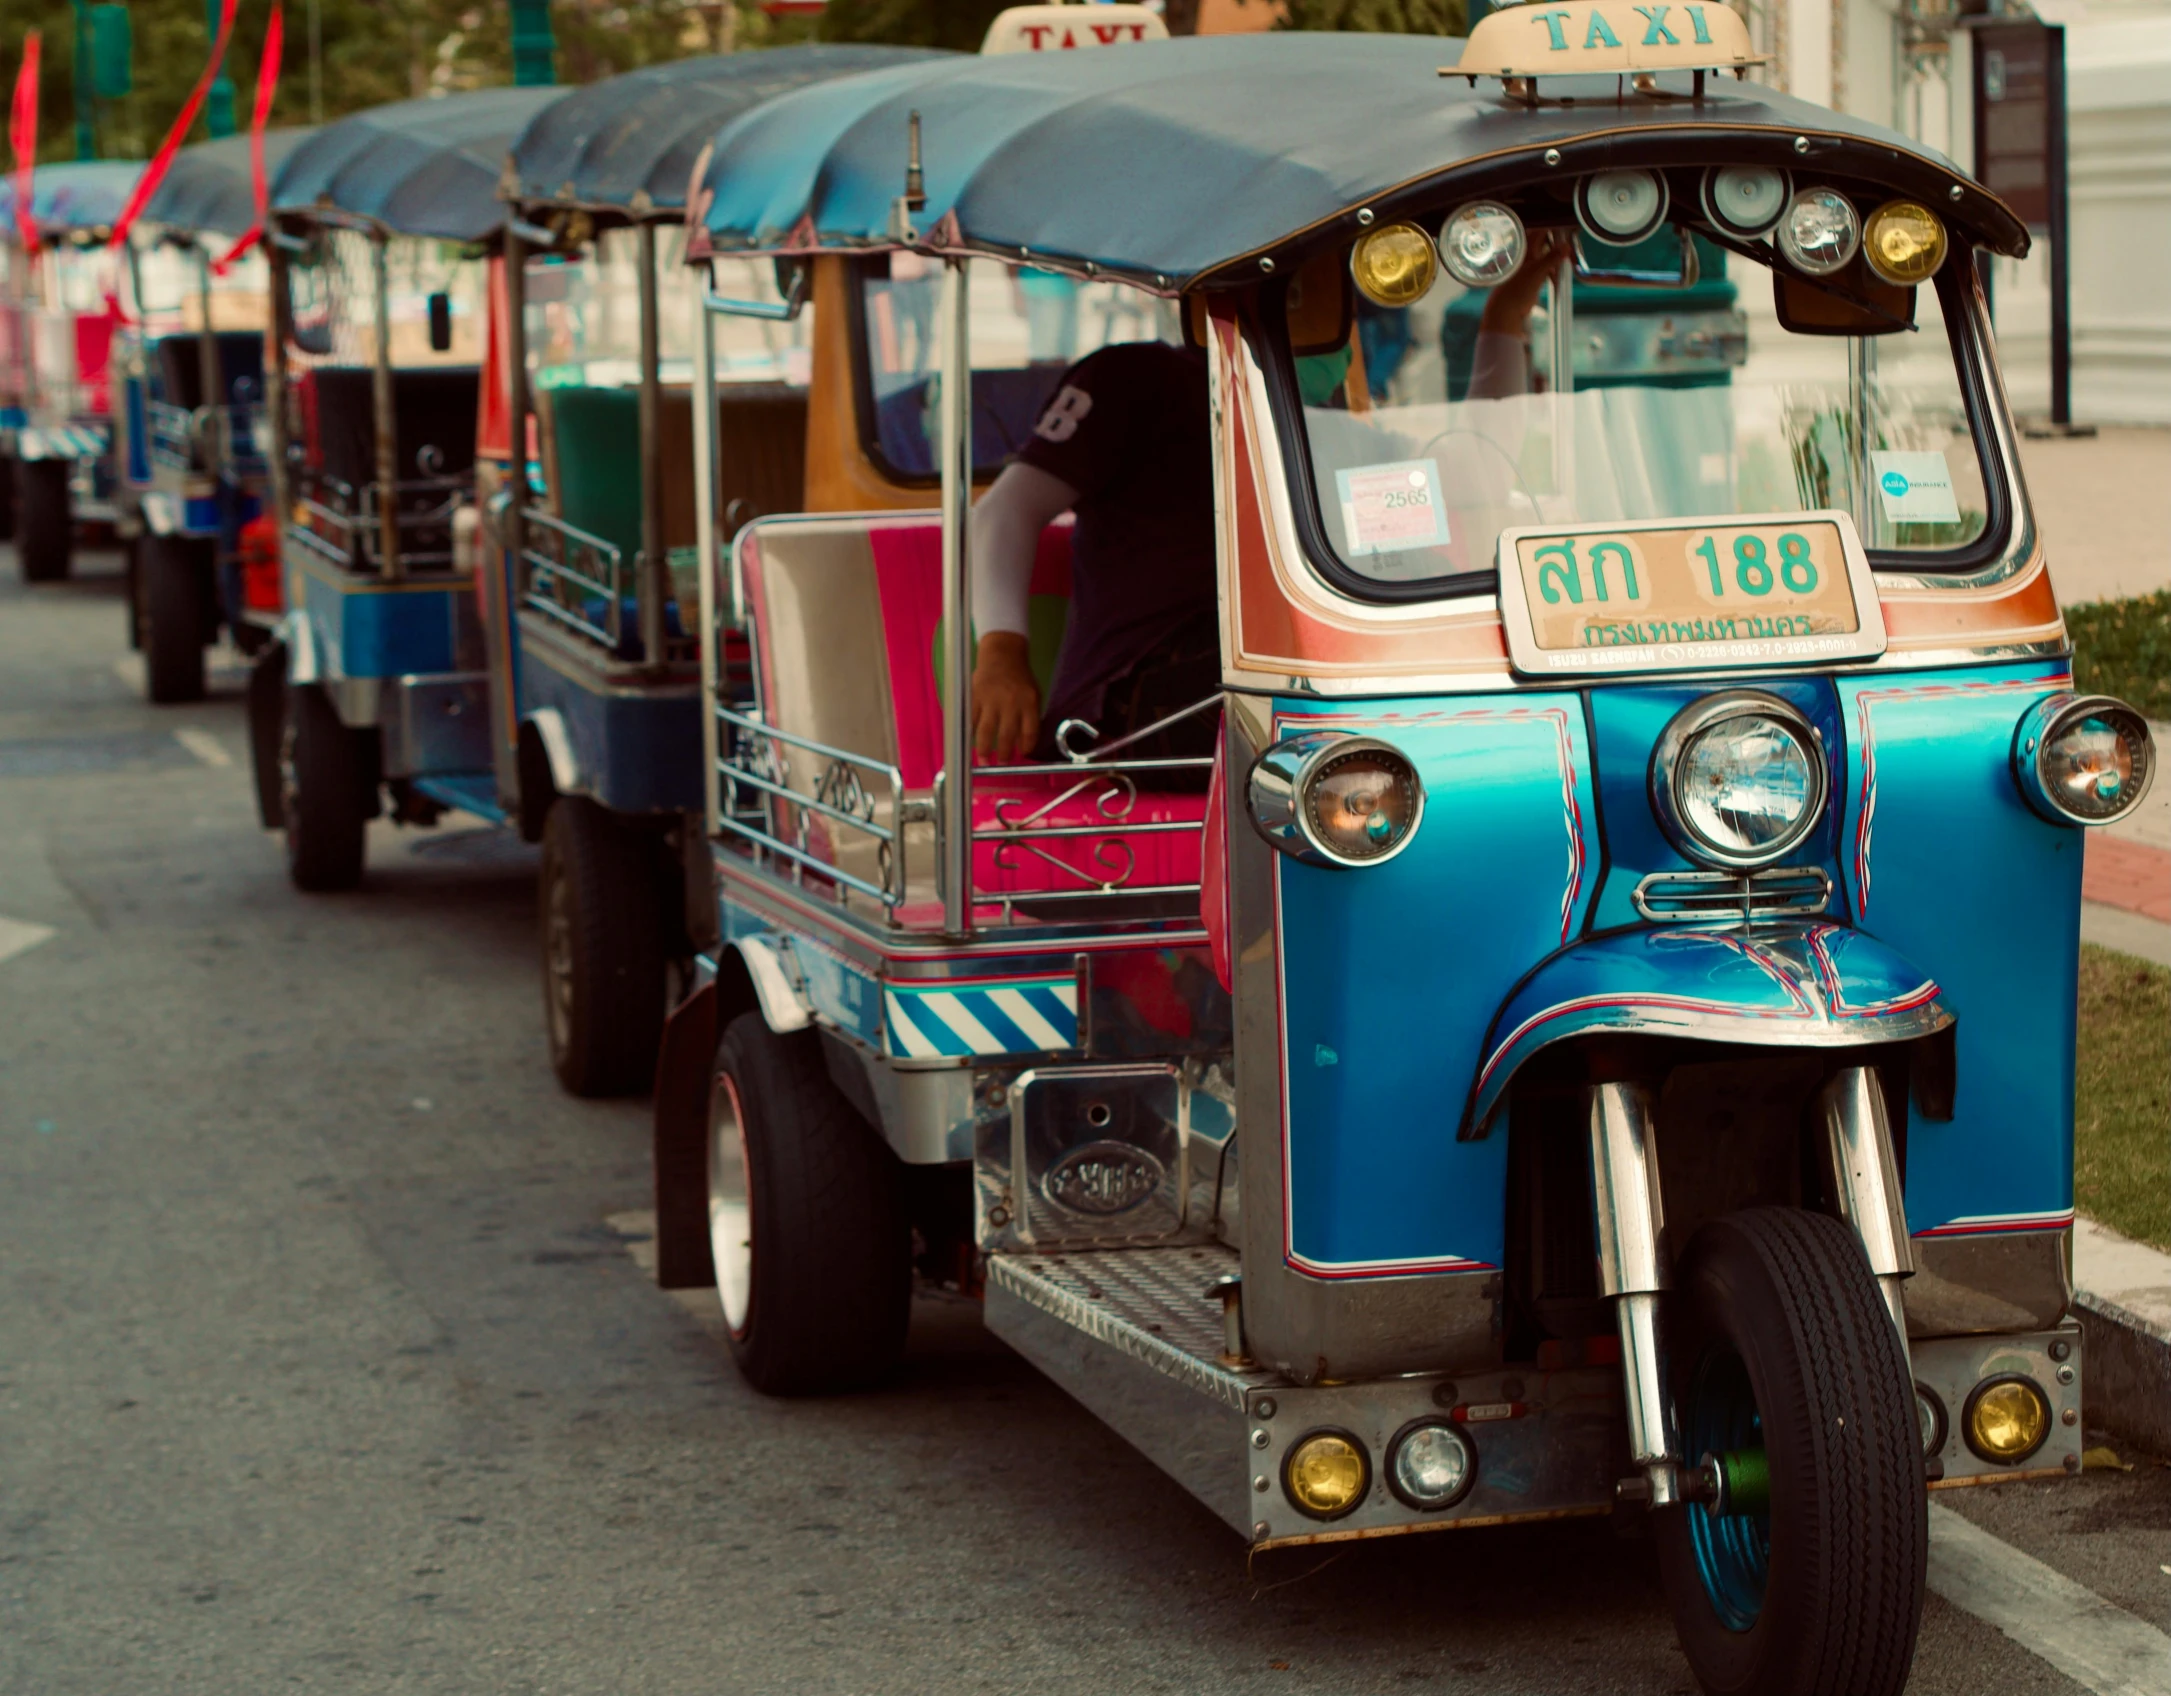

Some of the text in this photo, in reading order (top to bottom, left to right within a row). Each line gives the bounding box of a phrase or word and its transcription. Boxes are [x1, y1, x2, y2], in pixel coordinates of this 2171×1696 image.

[1531, 5, 1713, 51] TAXI
[1384, 488, 1428, 508] 2565
[1534, 532, 1818, 604] สก 188
[1583, 614, 1811, 646] กรงเทพมหานคร
[1548, 652, 1587, 668] ISUZU
